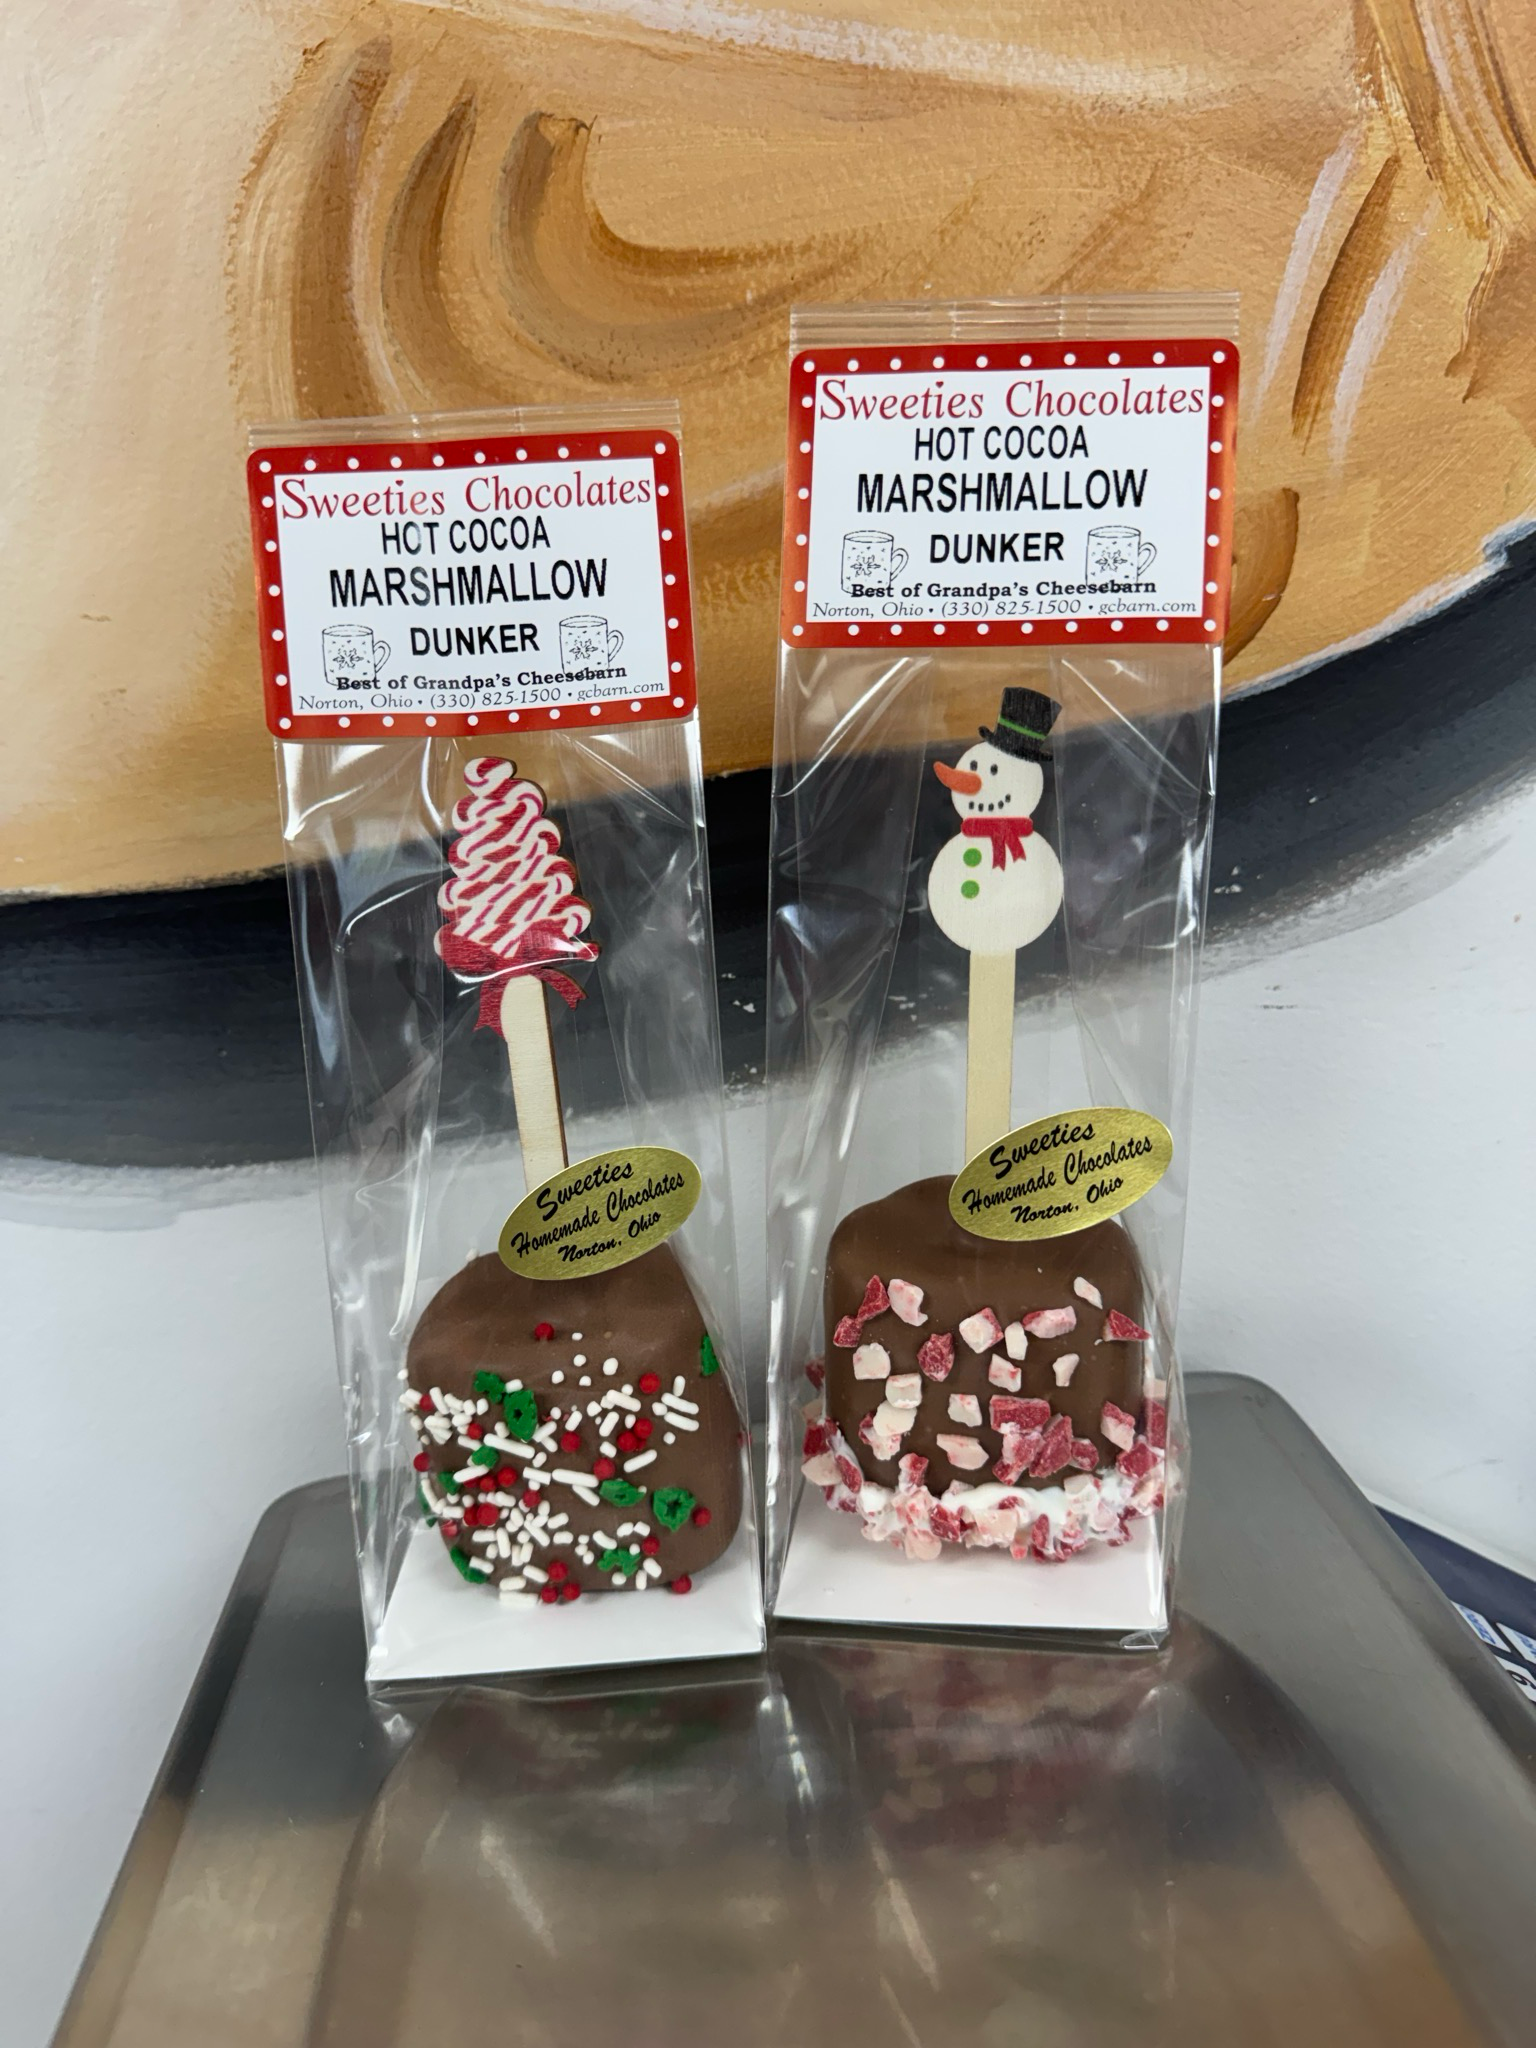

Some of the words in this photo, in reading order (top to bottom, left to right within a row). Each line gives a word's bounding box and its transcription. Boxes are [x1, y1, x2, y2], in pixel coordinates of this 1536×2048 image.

[819, 379, 984, 421] Sweeties
[1005, 378, 1204, 419] Chocolates
[914, 426, 975, 461] HOT
[984, 424, 1089, 460] COCOA
[281, 478, 445, 519] Sweeties
[465, 471, 651, 513] Chocolates
[856, 468, 1148, 513] MARSHMALLOW
[381, 521, 440, 556] HOT
[449, 515, 551, 552] COCOA
[929, 531, 1065, 564] DUNKER
[329, 558, 608, 608] MARSHMALLOW
[850, 583, 894, 598] Best
[901, 582, 922, 598] of
[926, 581, 1029, 602] Grandpa's
[1035, 579, 1157, 597] Cheesebarn
[812, 602, 875, 619] Norton,
[881, 601, 924, 618] Ohio
[941, 600, 990, 618] (330)
[995, 599, 1082, 616] 825-1500
[1097, 598, 1197, 616] gcbarn.com
[410, 623, 540, 657] DUNKER
[299, 694, 364, 711] Norton,
[370, 693, 413, 709] Ohio
[430, 691, 476, 710] (330)
[481, 687, 561, 707] 825-1500
[577, 681, 665, 701] gcbarn.com
[336, 675, 382, 691] Best
[388, 673, 408, 690] of
[413, 673, 512, 693] Grandpa's
[517, 665, 627, 687] Cheesebarn
[989, 1123, 1096, 1180] Sweeties
[536, 1162, 634, 1222] Sweeties
[961, 1166, 1057, 1215] Homemade
[1063, 1136, 1153, 1185] Chocolates
[1086, 1176, 1124, 1204] Ohio
[510, 1205, 600, 1258] Homemade
[606, 1172, 685, 1222] Chocolates
[628, 1211, 661, 1238] Ohio
